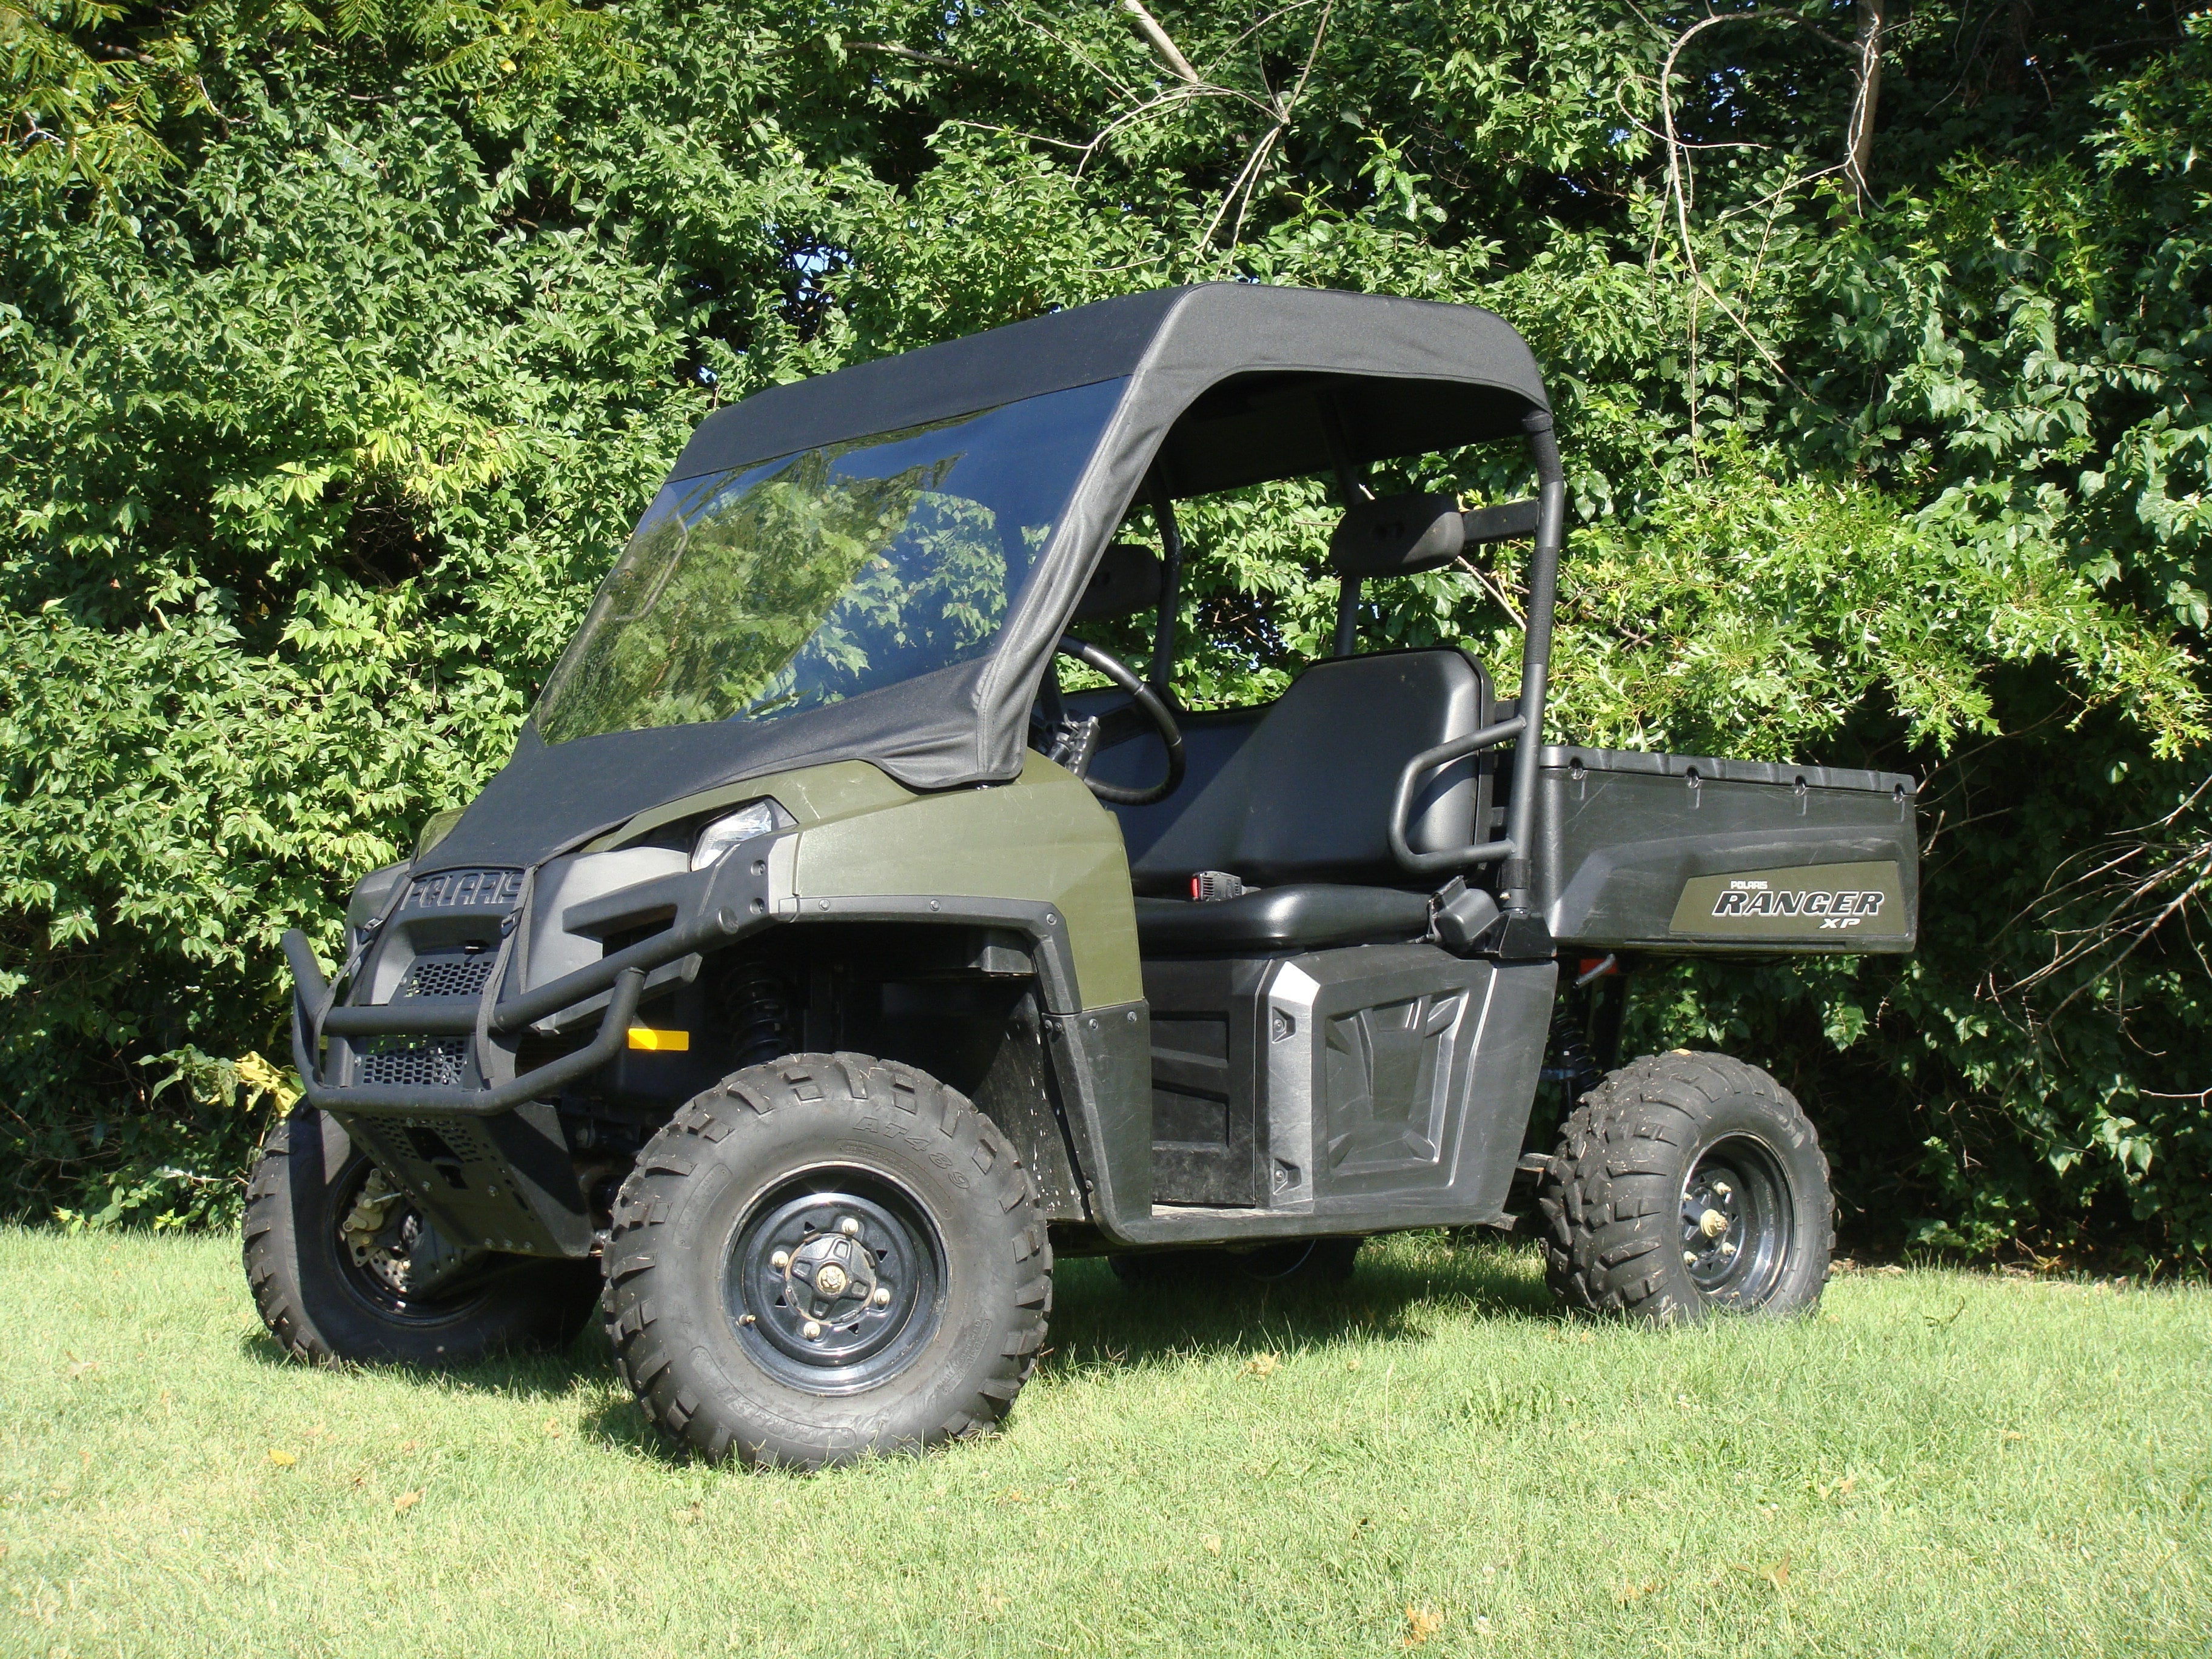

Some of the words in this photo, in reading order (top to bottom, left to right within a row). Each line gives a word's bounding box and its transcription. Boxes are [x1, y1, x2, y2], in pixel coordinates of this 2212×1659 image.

[400, 871, 525, 911] POLARIS
[1731, 880, 1768, 890] POLARIS
[1712, 891, 1885, 917] RANGER
[1819, 918, 1861, 929] XP
